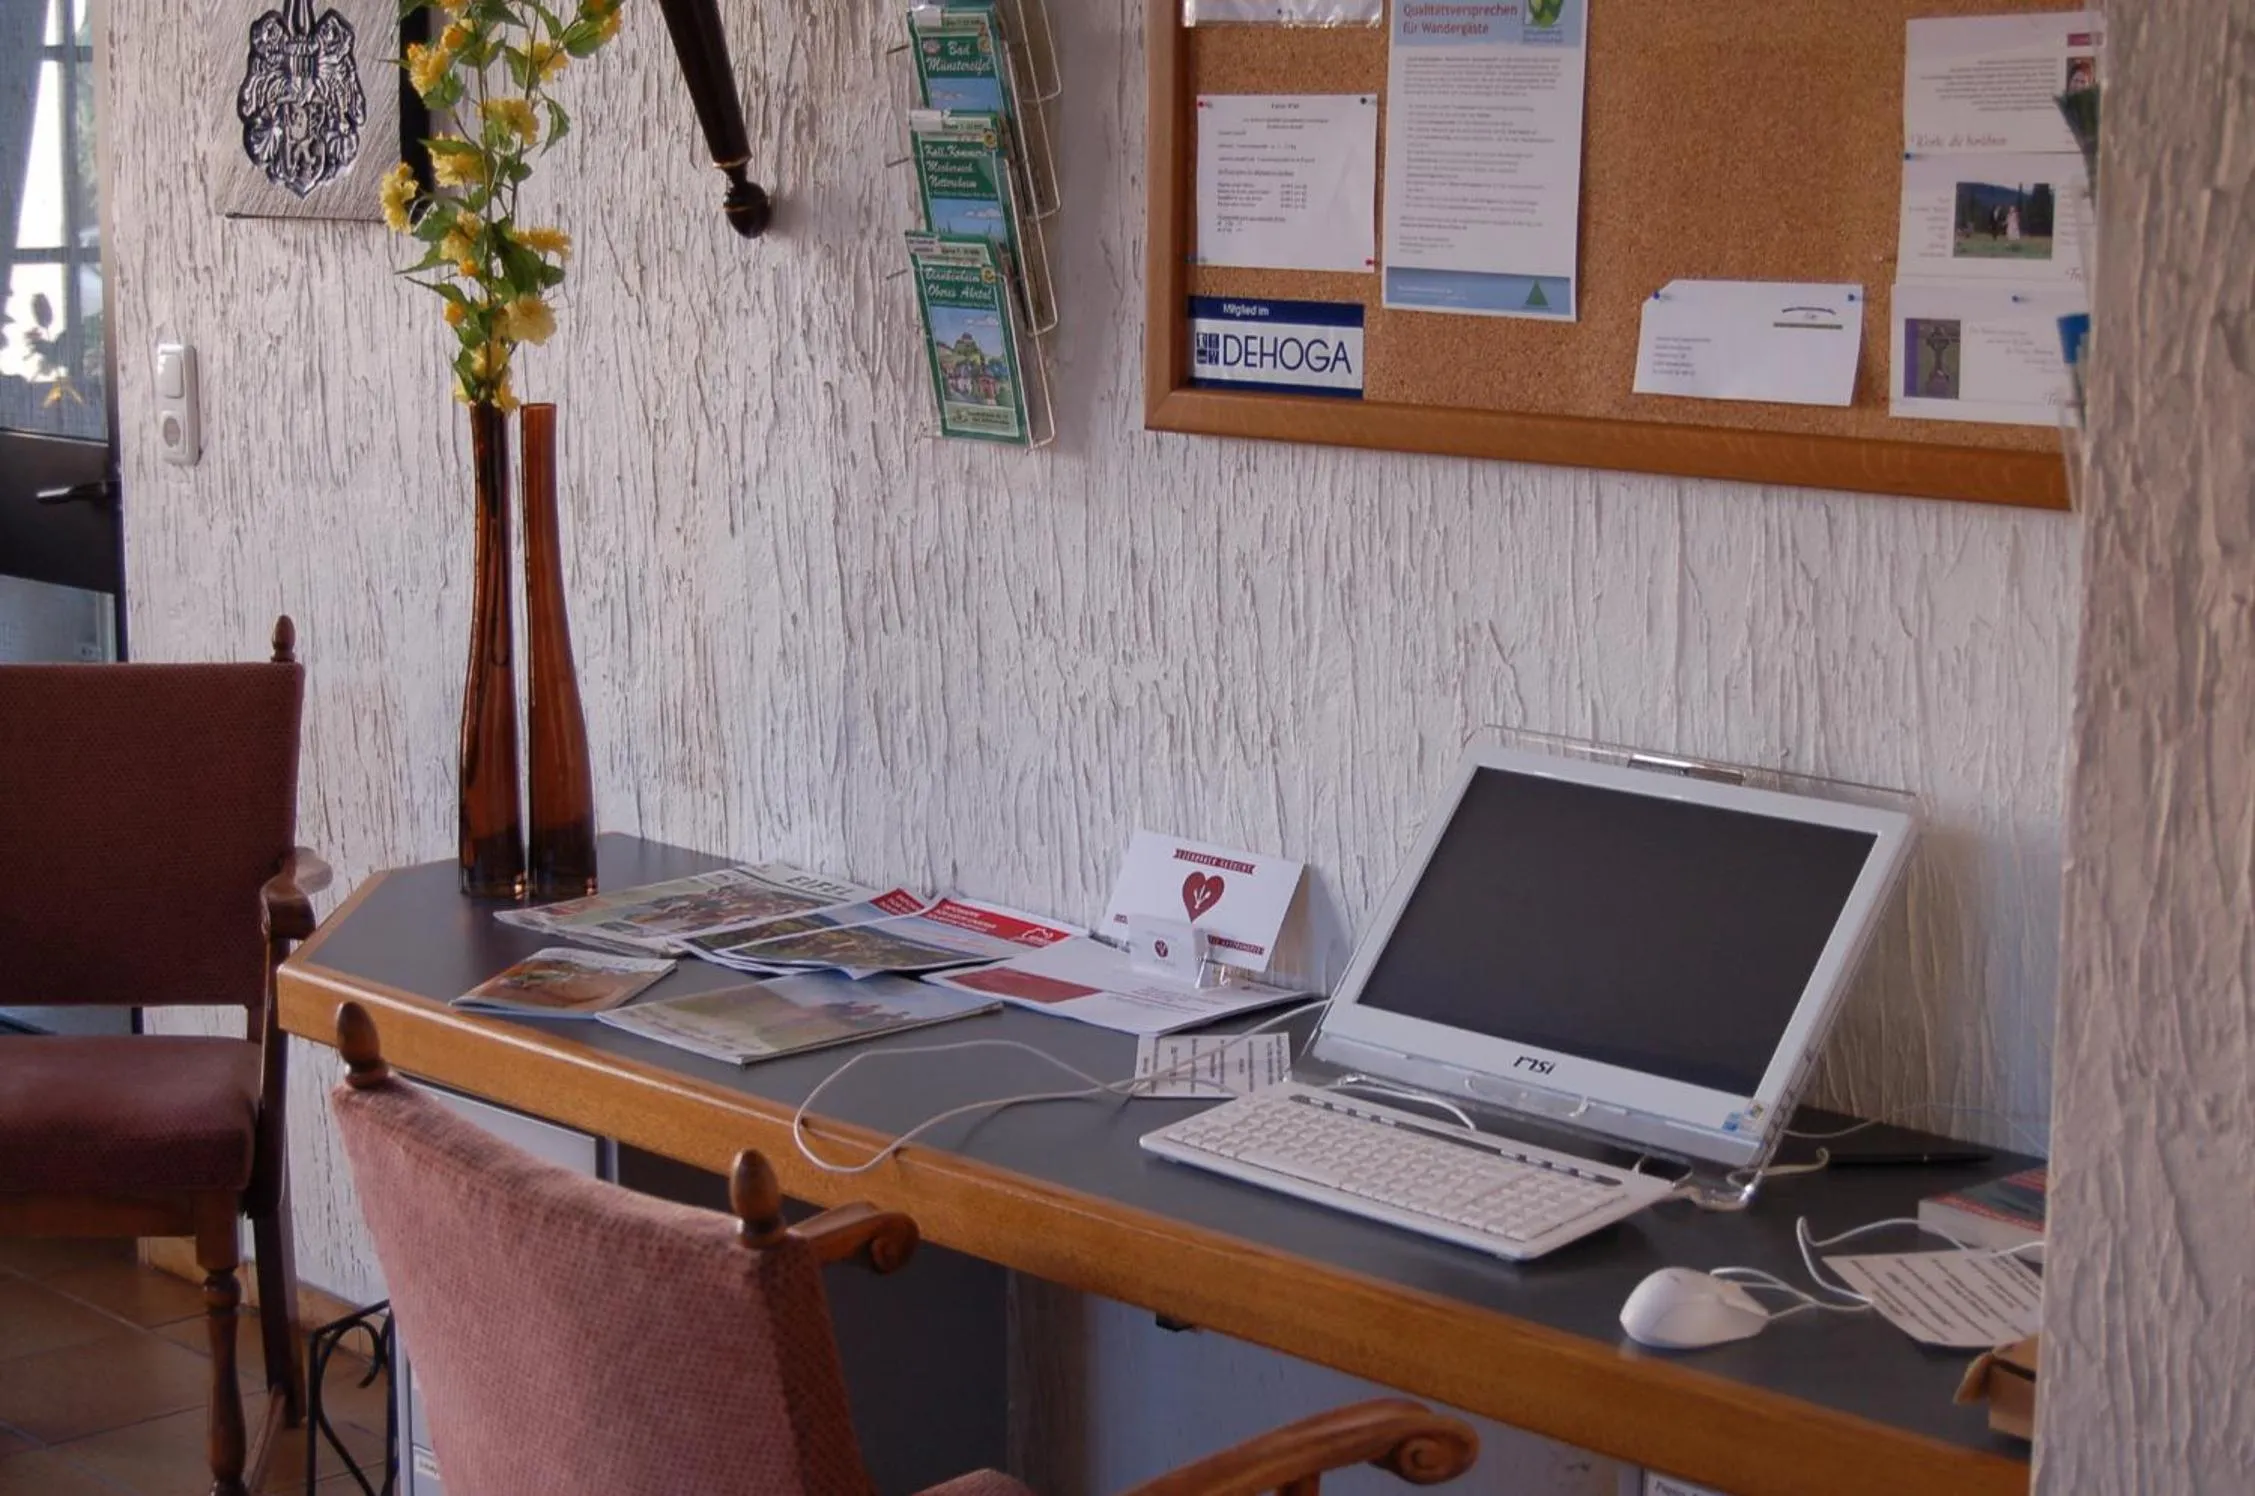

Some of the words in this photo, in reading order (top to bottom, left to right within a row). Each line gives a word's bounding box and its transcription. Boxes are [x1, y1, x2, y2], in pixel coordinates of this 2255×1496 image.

[1402, 3, 1518, 20] Qualitätsversprechen
[1402, 22, 1418, 34] für
[1421, 22, 1489, 36] Wandergäste
[947, 40, 970, 56] Bad
[1222, 303, 1256, 317] Mitglied
[1258, 305, 1270, 316] im
[1223, 334, 1353, 375] DEHOGA
[1513, 1055, 1556, 1075] msi
